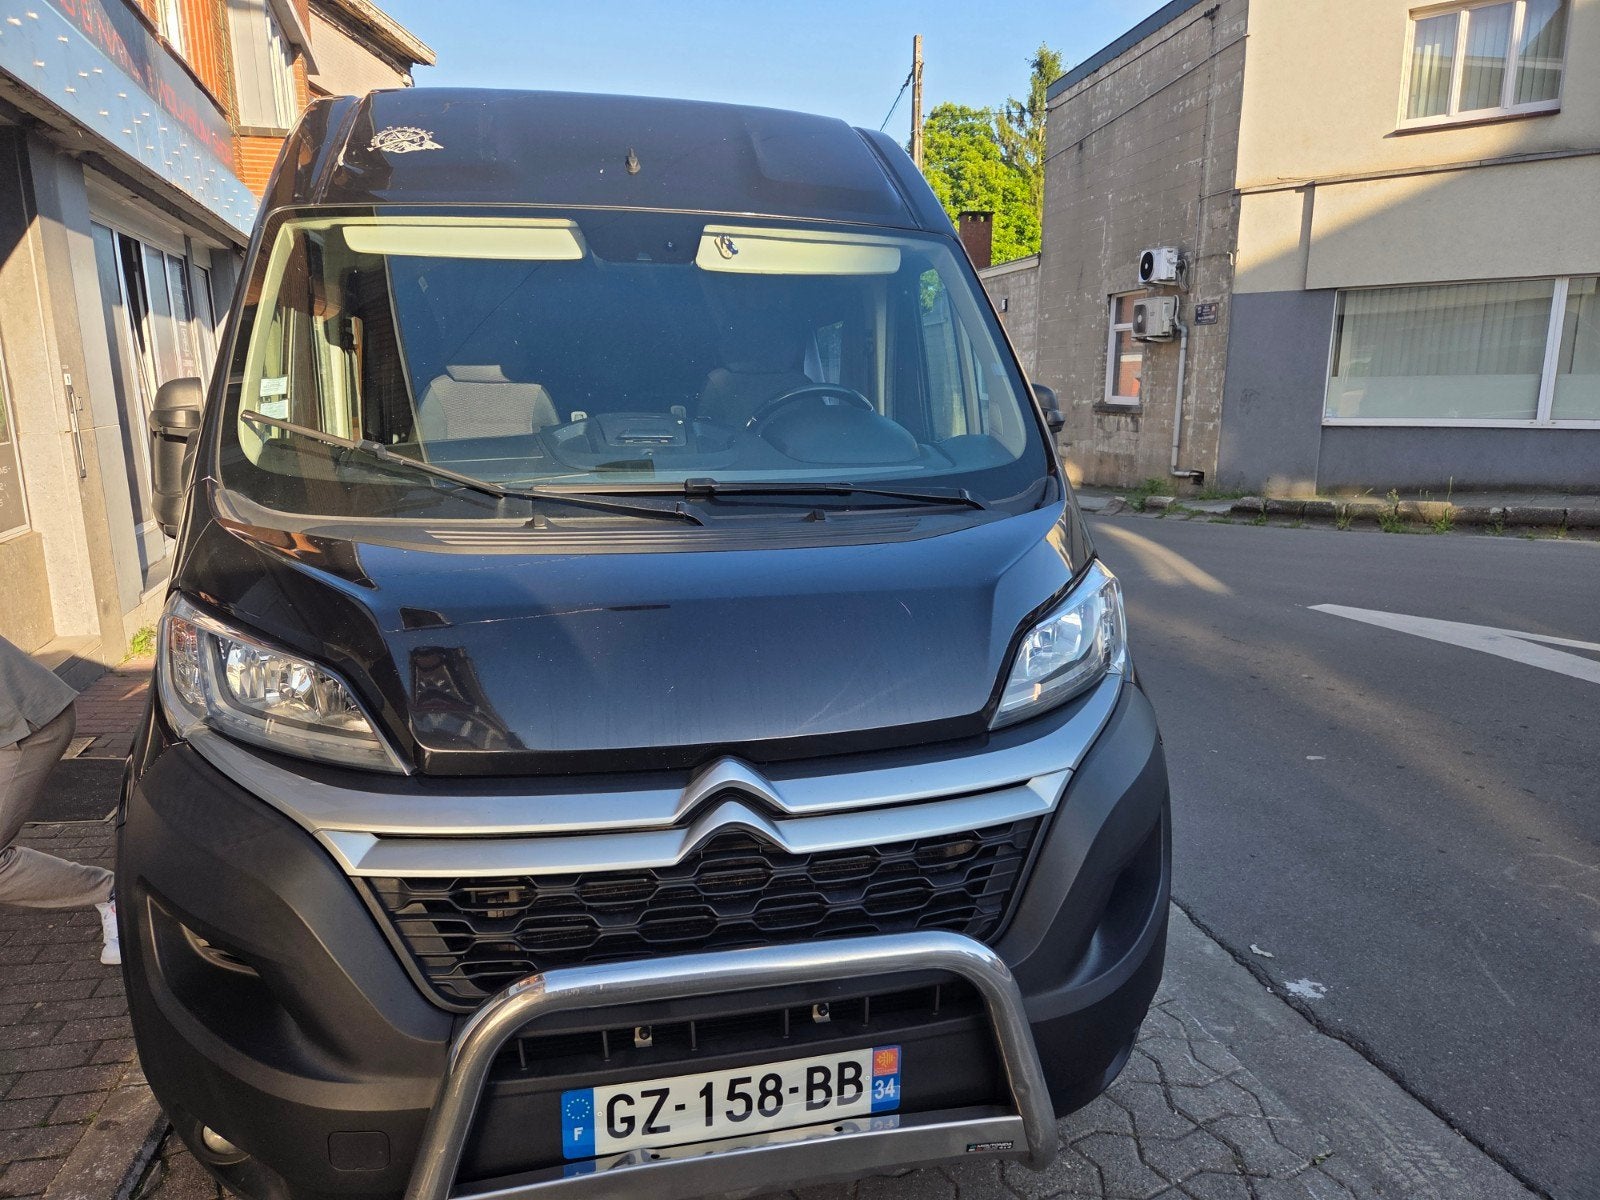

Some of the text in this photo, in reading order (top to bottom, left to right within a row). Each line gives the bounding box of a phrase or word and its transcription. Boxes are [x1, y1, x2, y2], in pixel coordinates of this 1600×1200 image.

[606, 1060, 864, 1139] GZ-158-BB
[874, 1077, 896, 1100] 34
[573, 1126, 583, 1141] F
